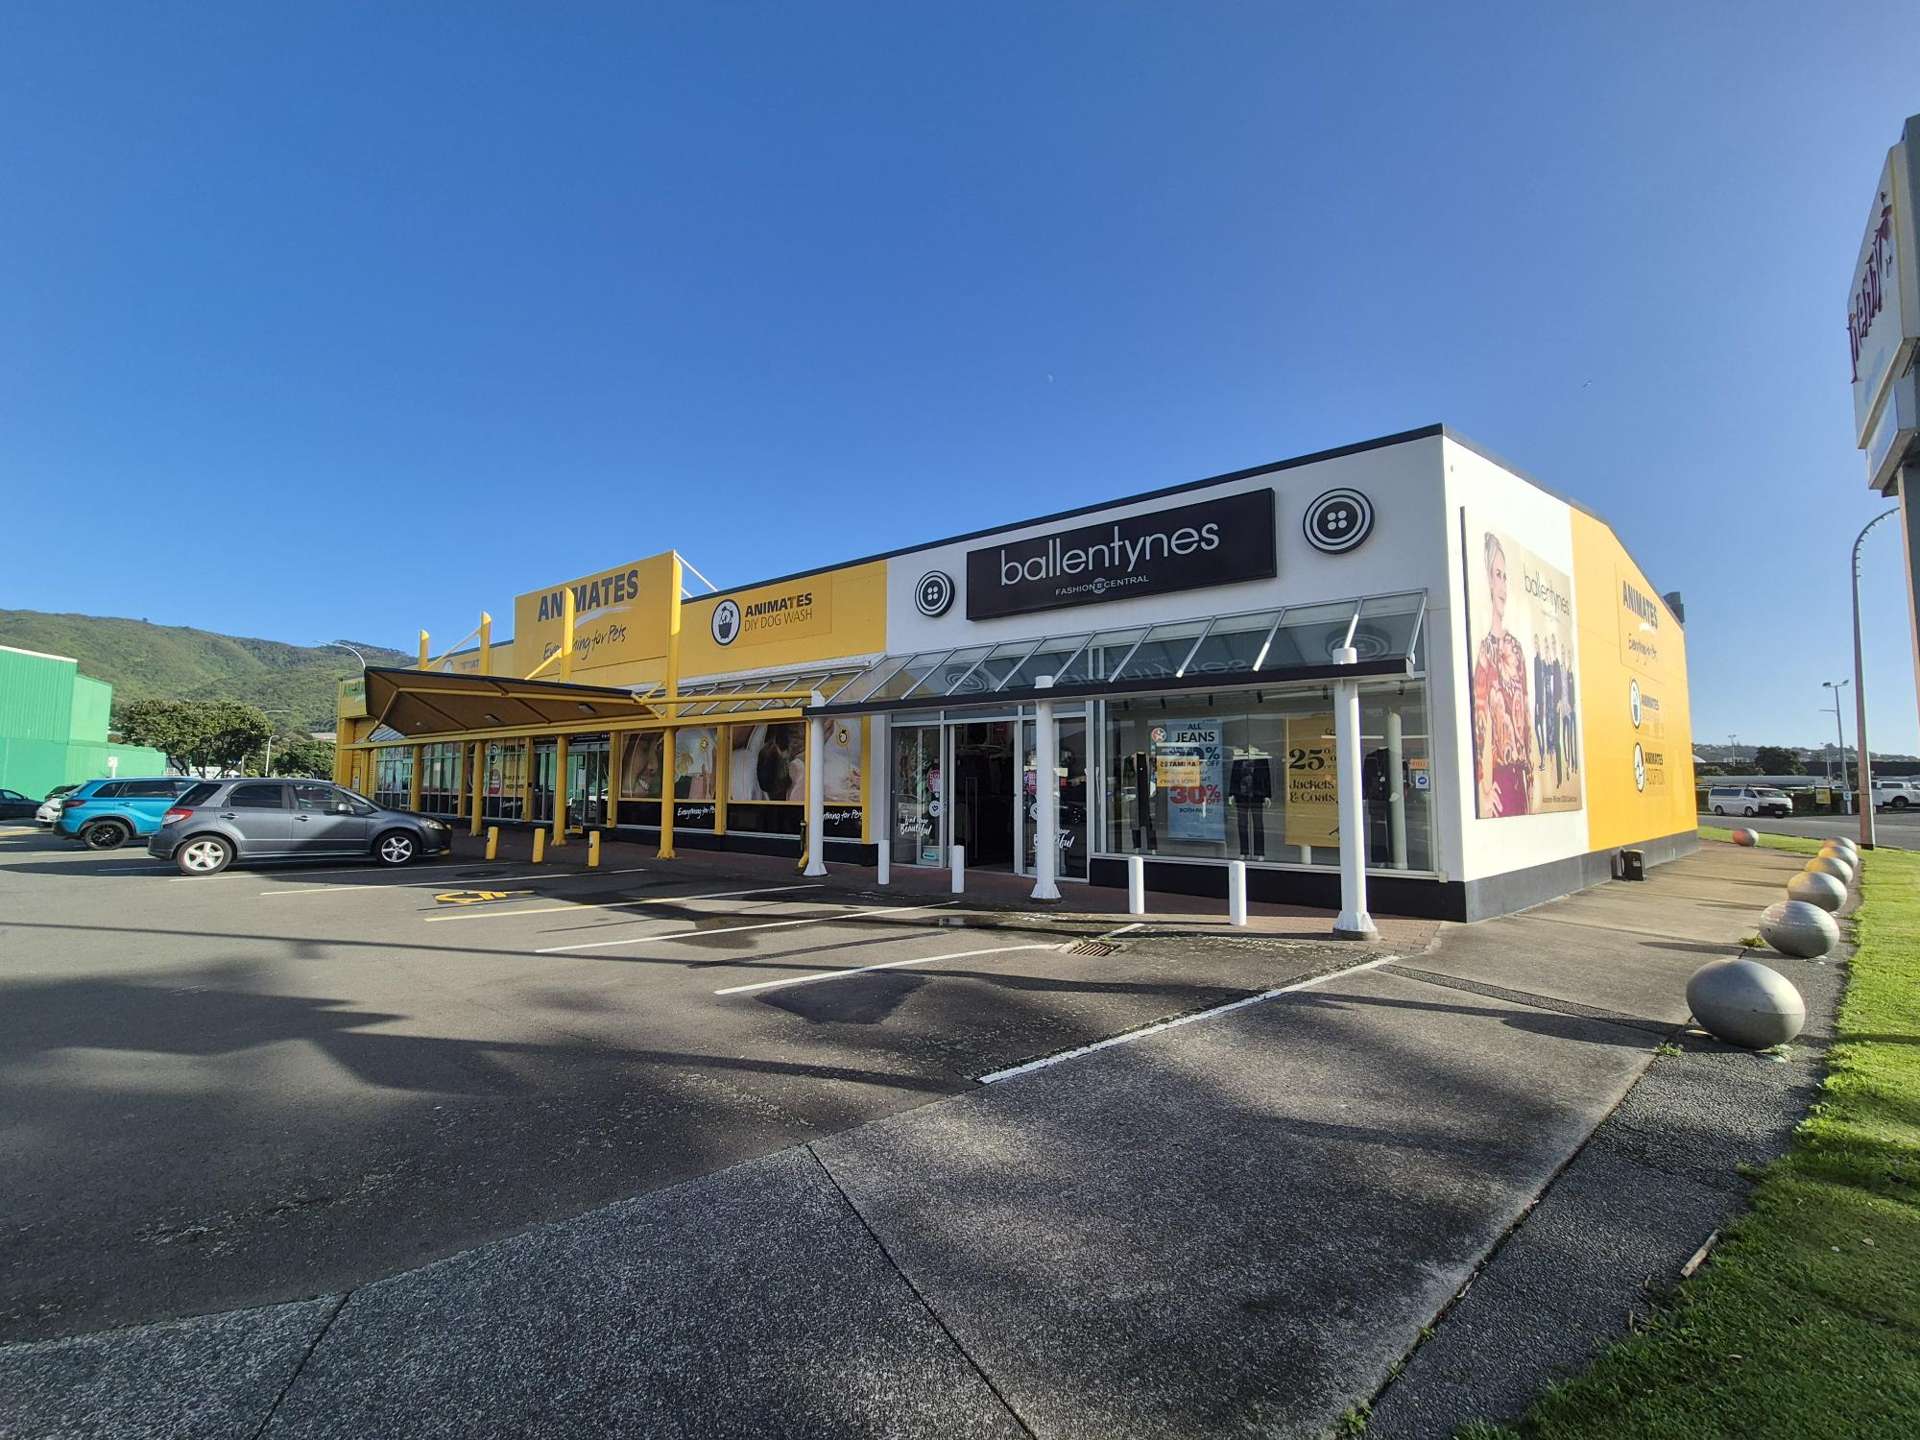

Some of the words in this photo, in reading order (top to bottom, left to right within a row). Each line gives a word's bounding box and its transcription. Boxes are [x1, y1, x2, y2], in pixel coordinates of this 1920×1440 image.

[1001, 522, 1220, 586] ballentynes
[537, 569, 639, 622] ANMATES
[1055, 582, 1096, 596] FASHION
[1103, 574, 1149, 589] CENTRAL
[744, 592, 813, 618] ANIMATES
[744, 618, 759, 632] DIY
[760, 614, 782, 630] DOG
[783, 607, 813, 625] WASH
[607, 624, 627, 644] Pets
[1175, 731, 1216, 743] JEANS
[1289, 779, 1335, 790] Jackets
[1289, 791, 1299, 803] &
